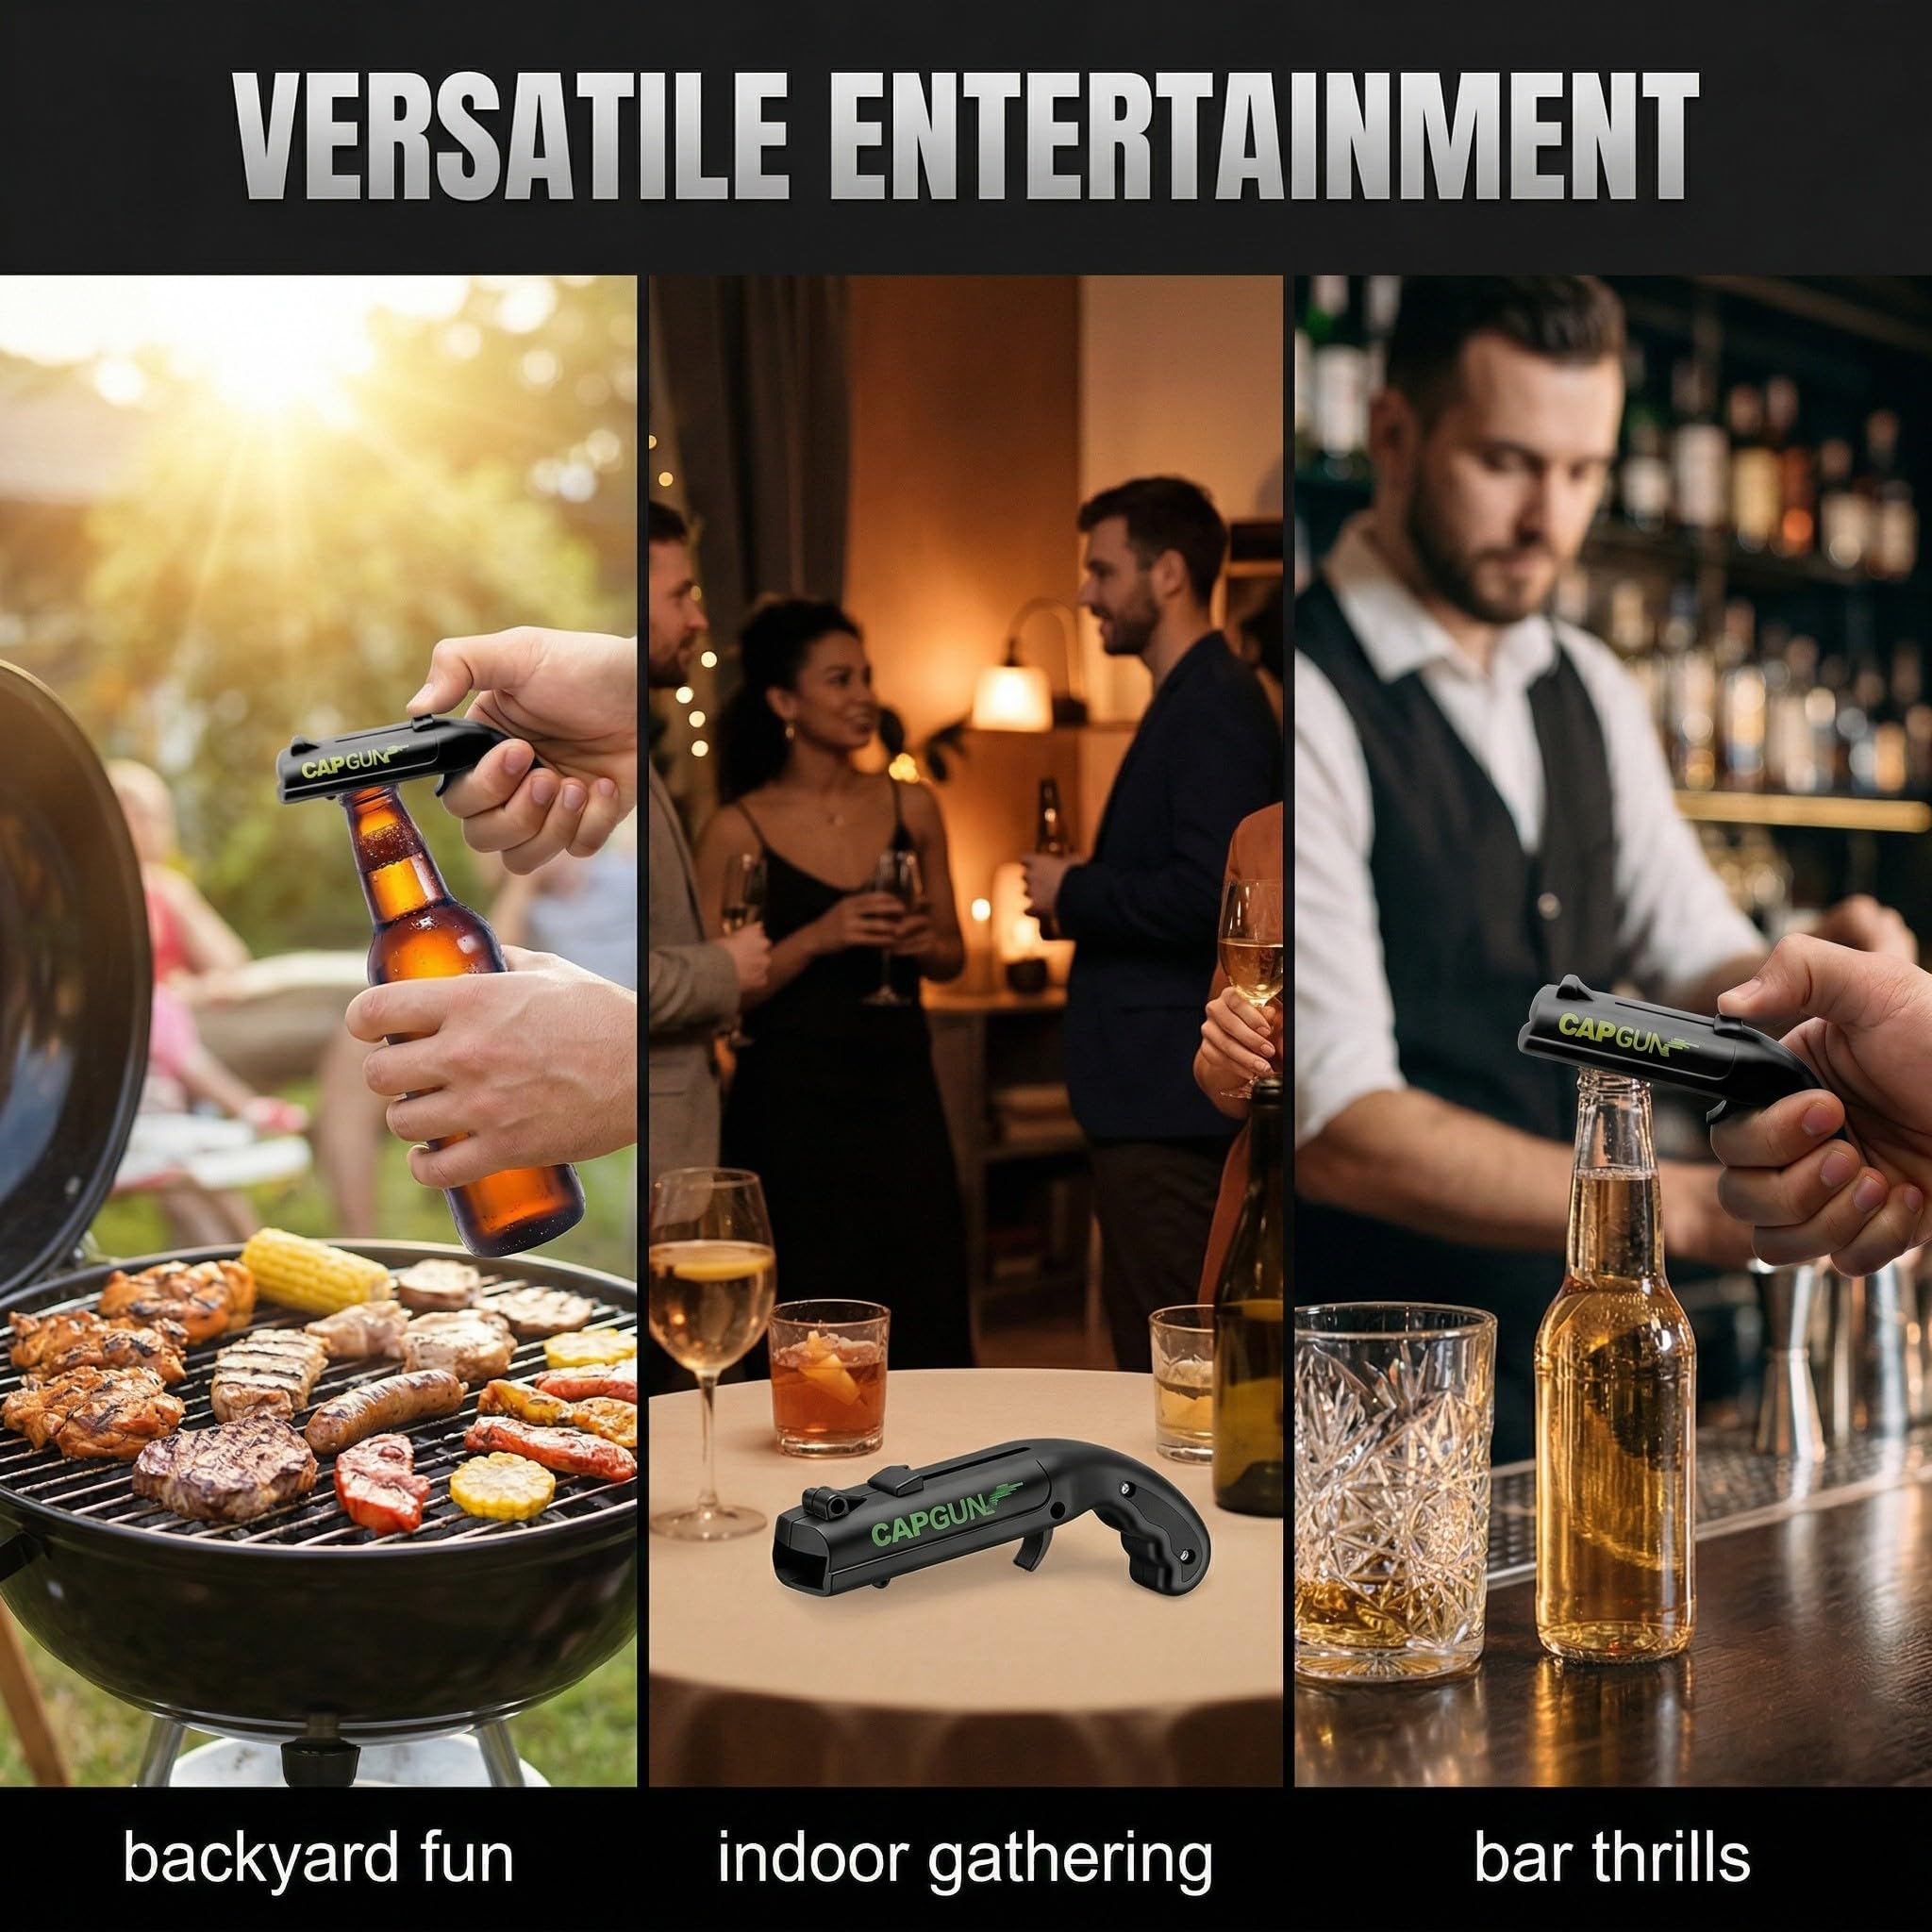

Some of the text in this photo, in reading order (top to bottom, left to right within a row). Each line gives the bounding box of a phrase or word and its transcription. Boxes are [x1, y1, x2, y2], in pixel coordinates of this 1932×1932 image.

[301, 749, 391, 779] CAPGUN
[1558, 1012, 1670, 1057] CAPGUN
[871, 1493, 995, 1548] CAPGUN
